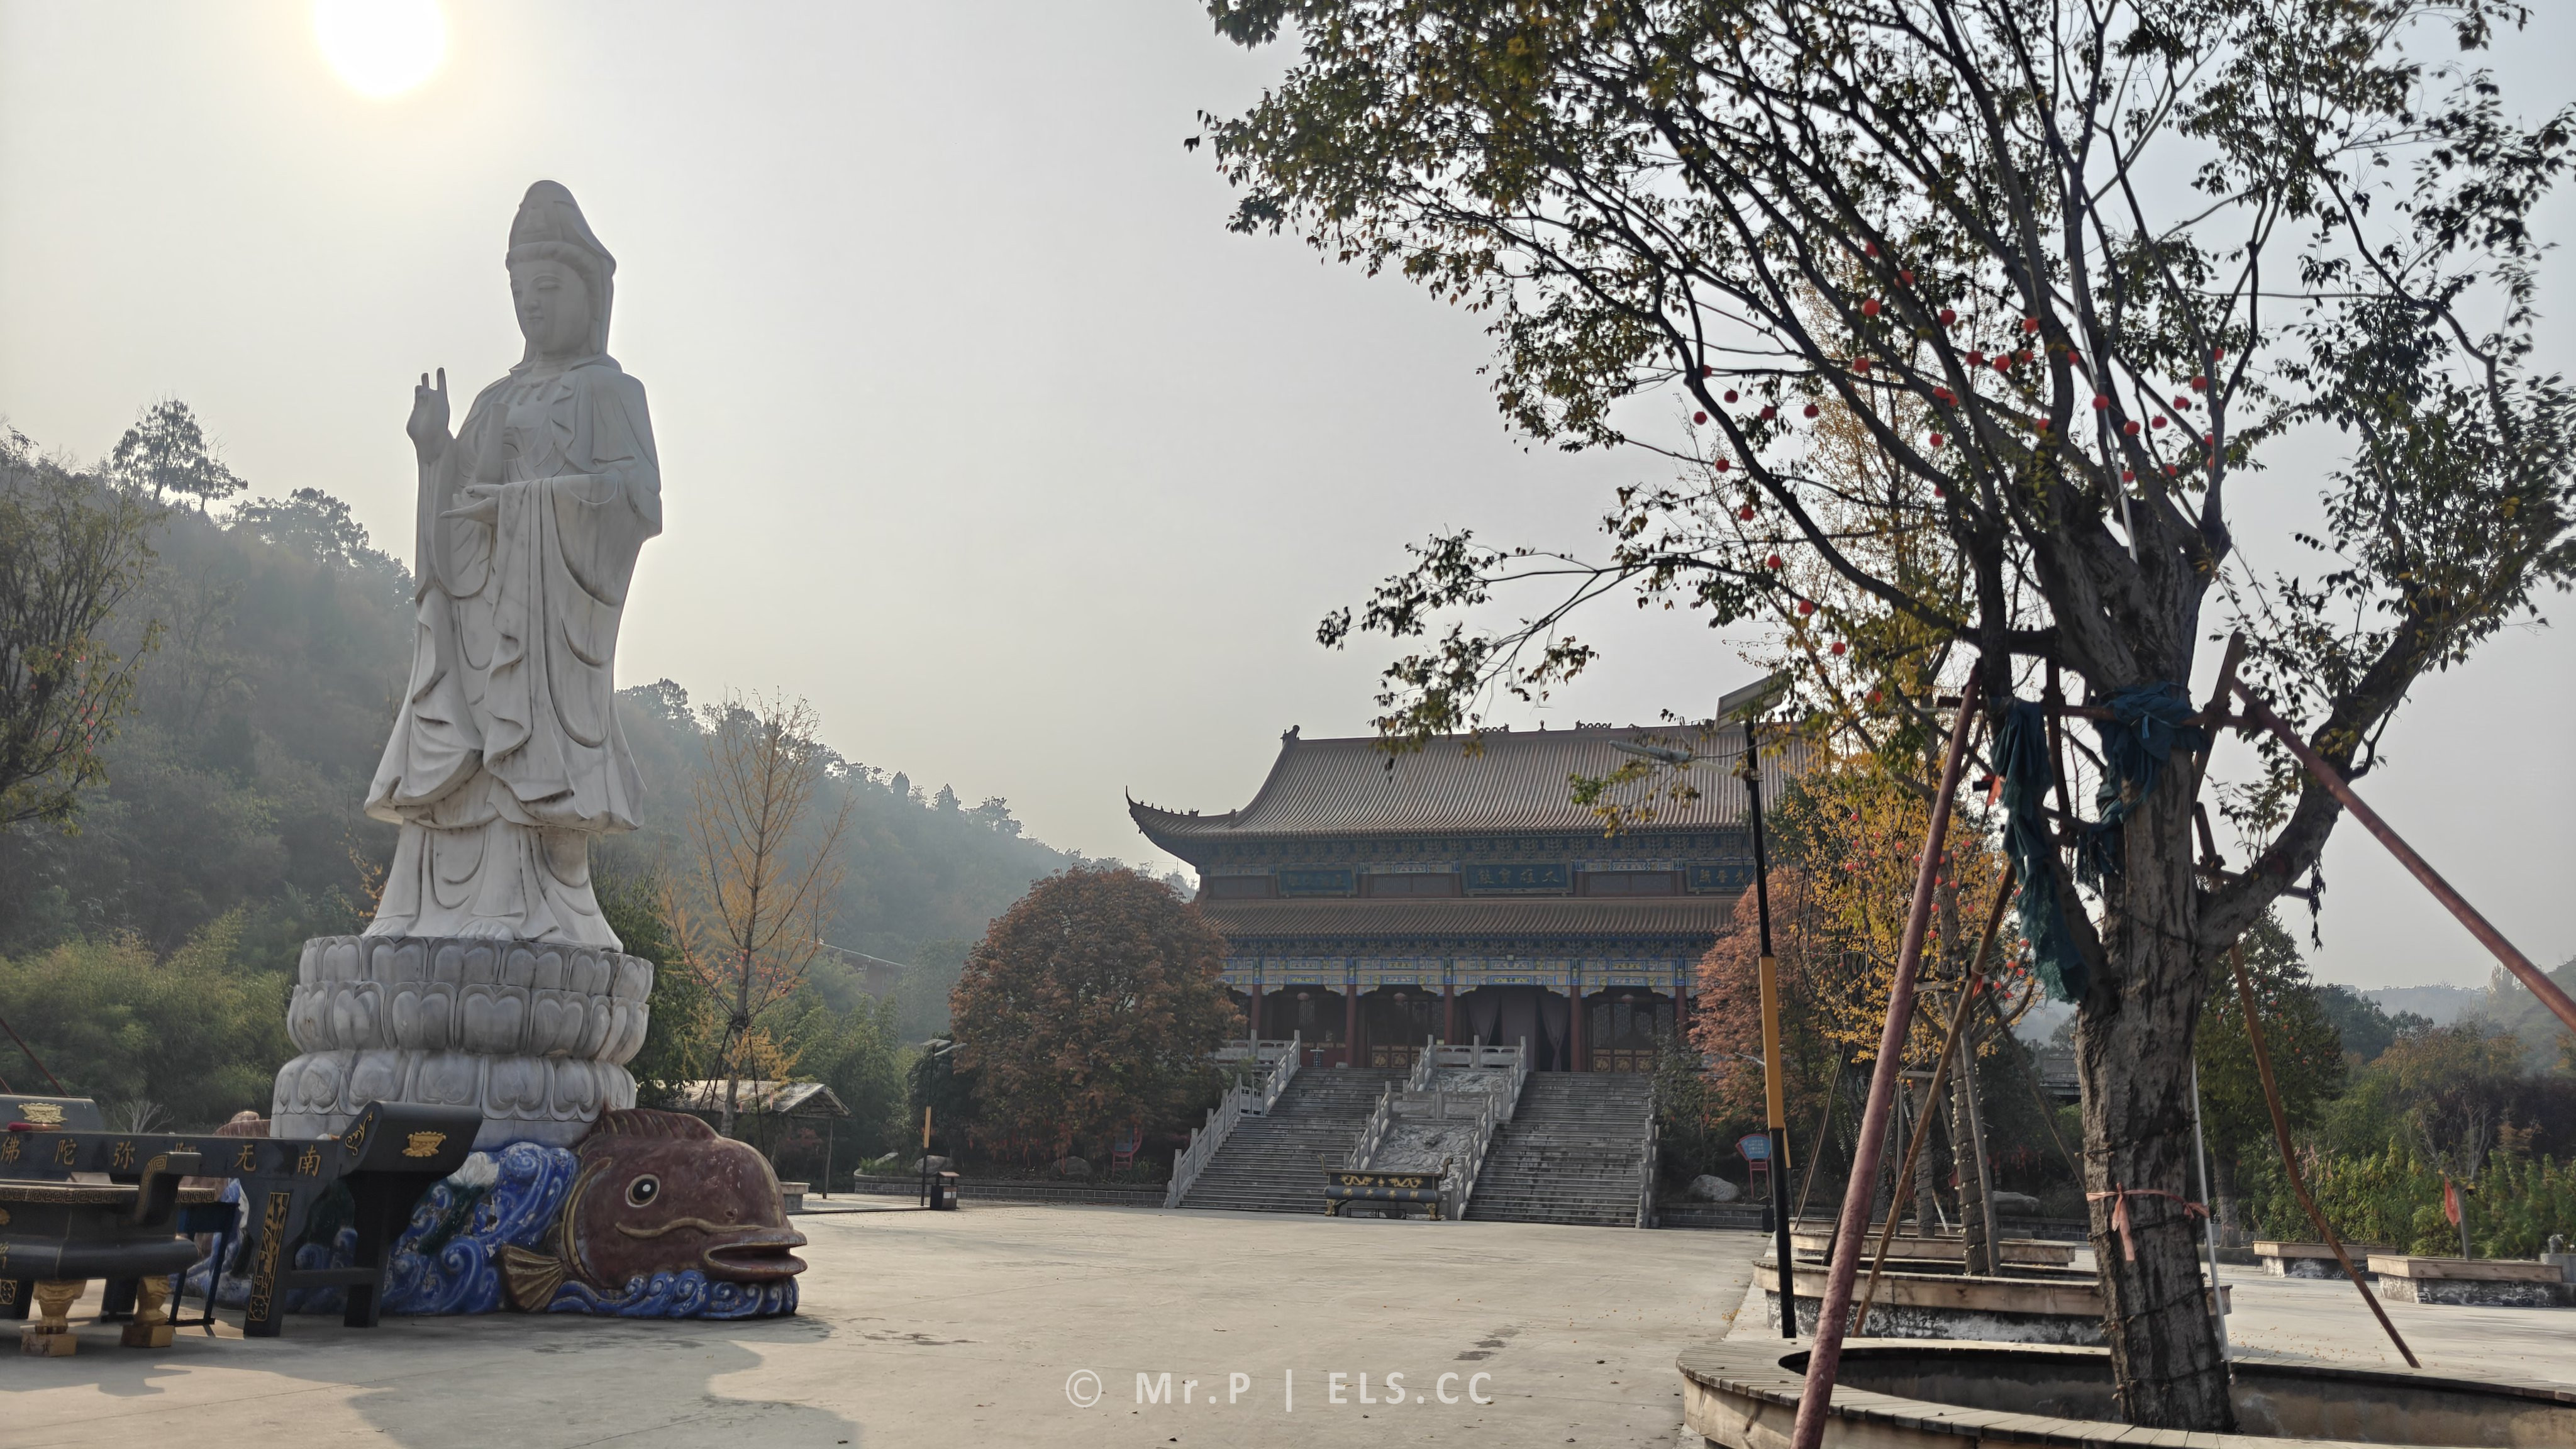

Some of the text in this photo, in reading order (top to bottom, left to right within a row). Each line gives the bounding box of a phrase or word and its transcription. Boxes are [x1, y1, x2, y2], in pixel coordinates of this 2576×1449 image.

[1, 1135, 321, 1177] 南无弥陀佛
